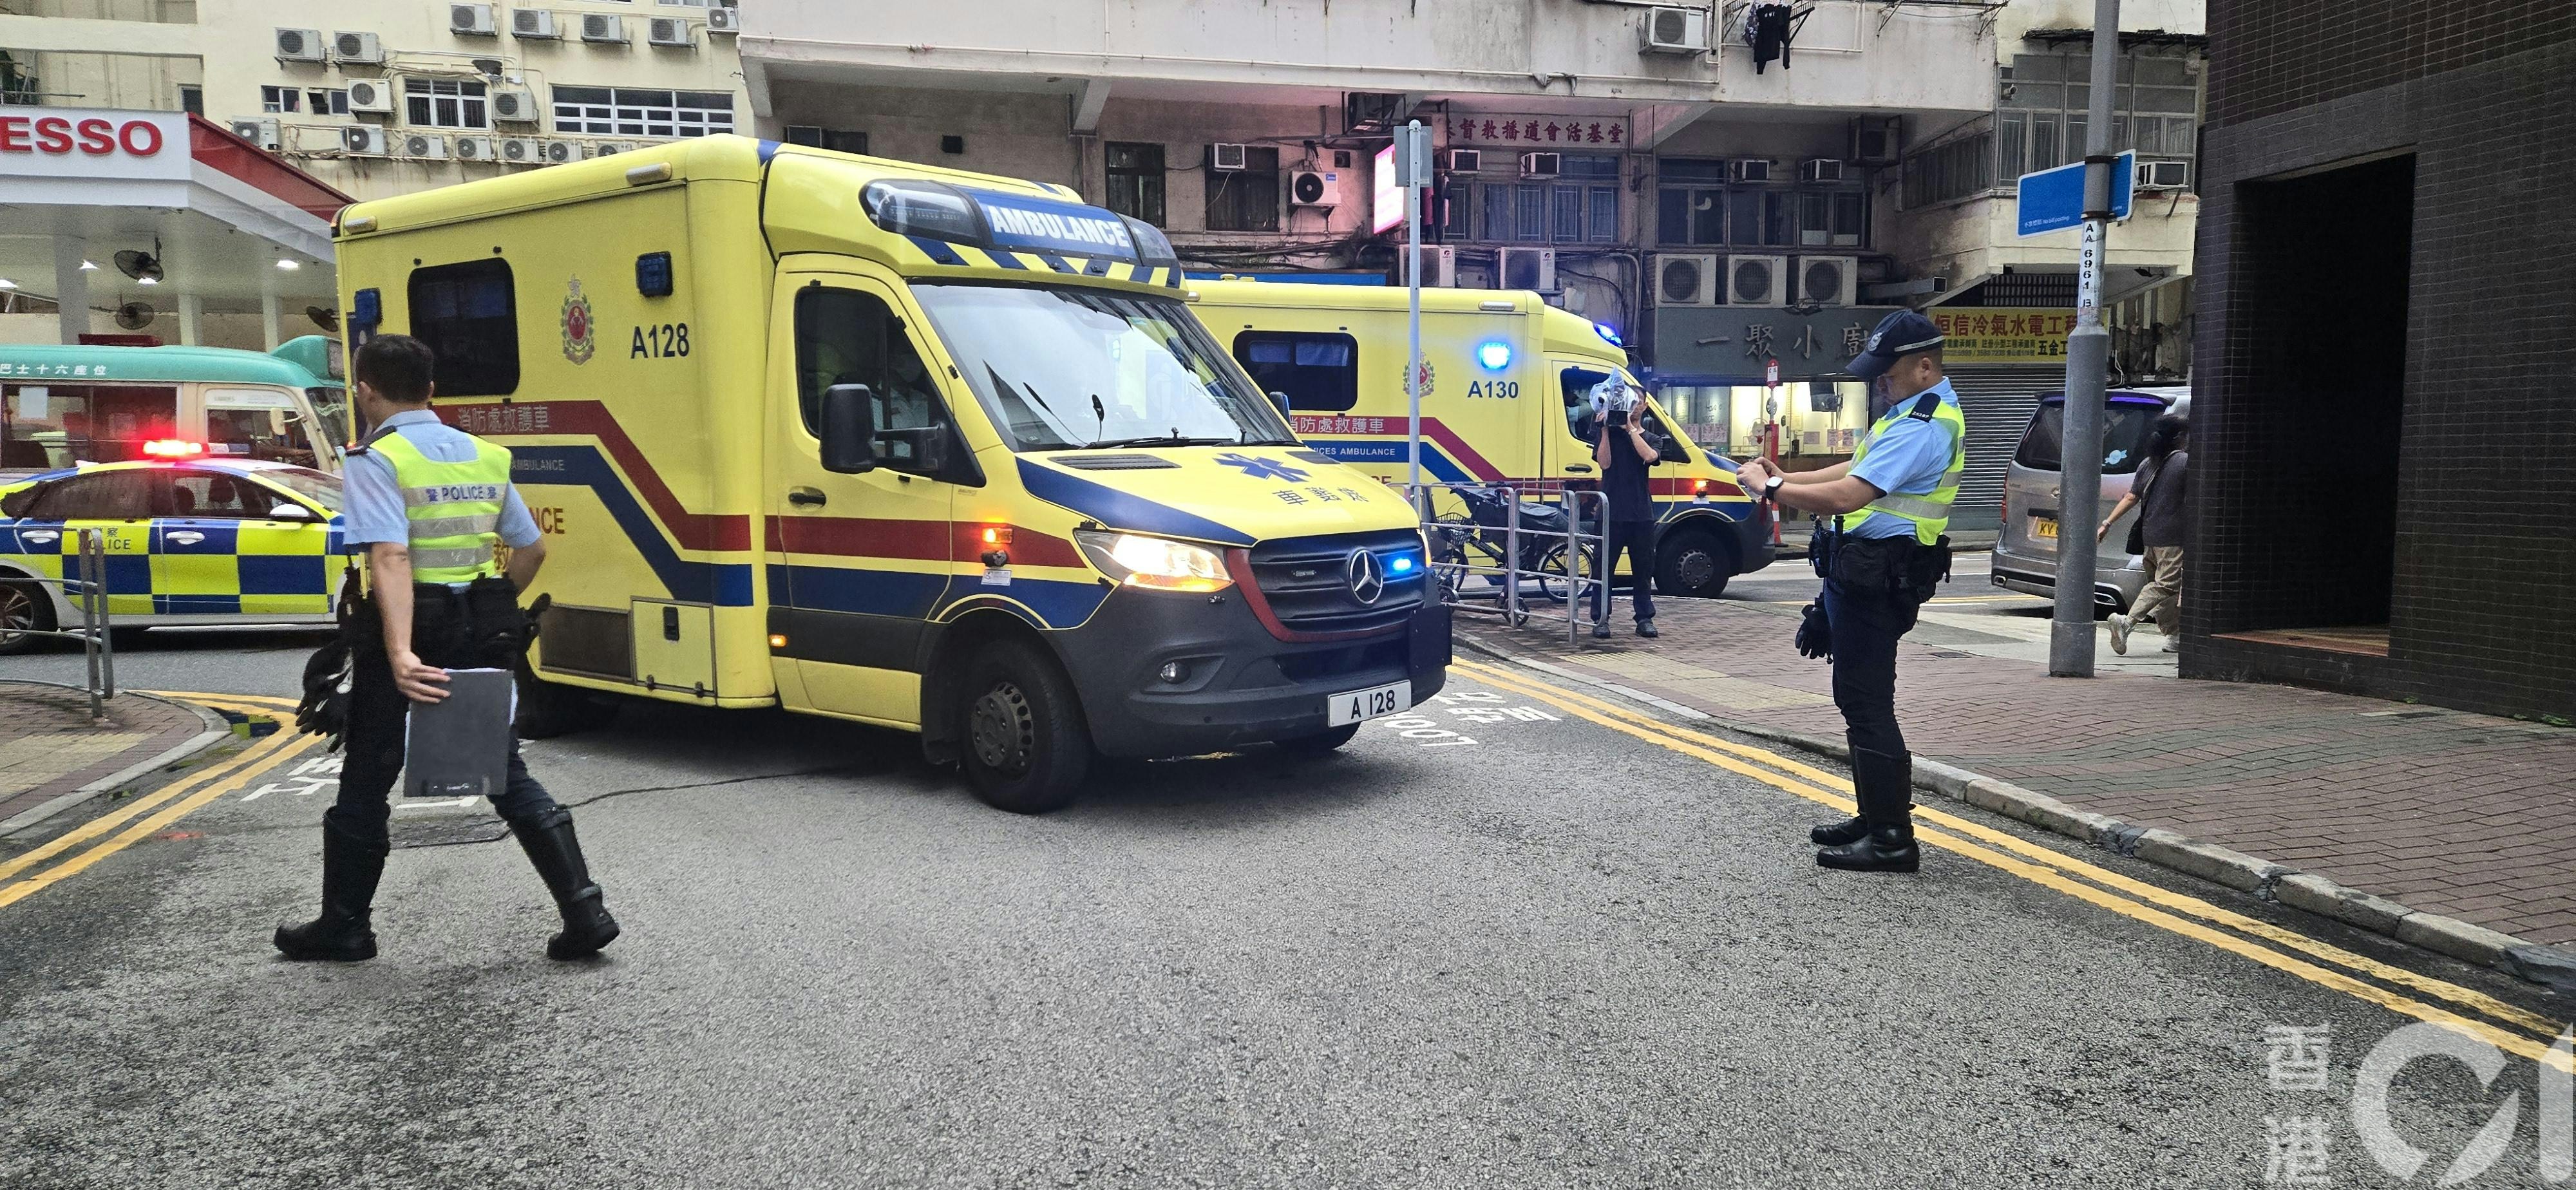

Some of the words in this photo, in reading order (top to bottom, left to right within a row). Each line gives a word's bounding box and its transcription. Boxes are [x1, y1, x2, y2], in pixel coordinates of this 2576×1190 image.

[0, 117, 163, 156] ESSO
[987, 205, 1130, 247] AMBULANCE
[630, 323, 689, 359] A128
[1467, 381, 1519, 399] A130
[458, 406, 549, 433] 消防處救護車
[511, 459, 565, 471] AMBULANCE
[1340, 448, 1396, 456] AMBULANCE
[441, 486, 484, 500] POLICE
[1351, 697, 1361, 719] A
[1370, 690, 1395, 715] 128
